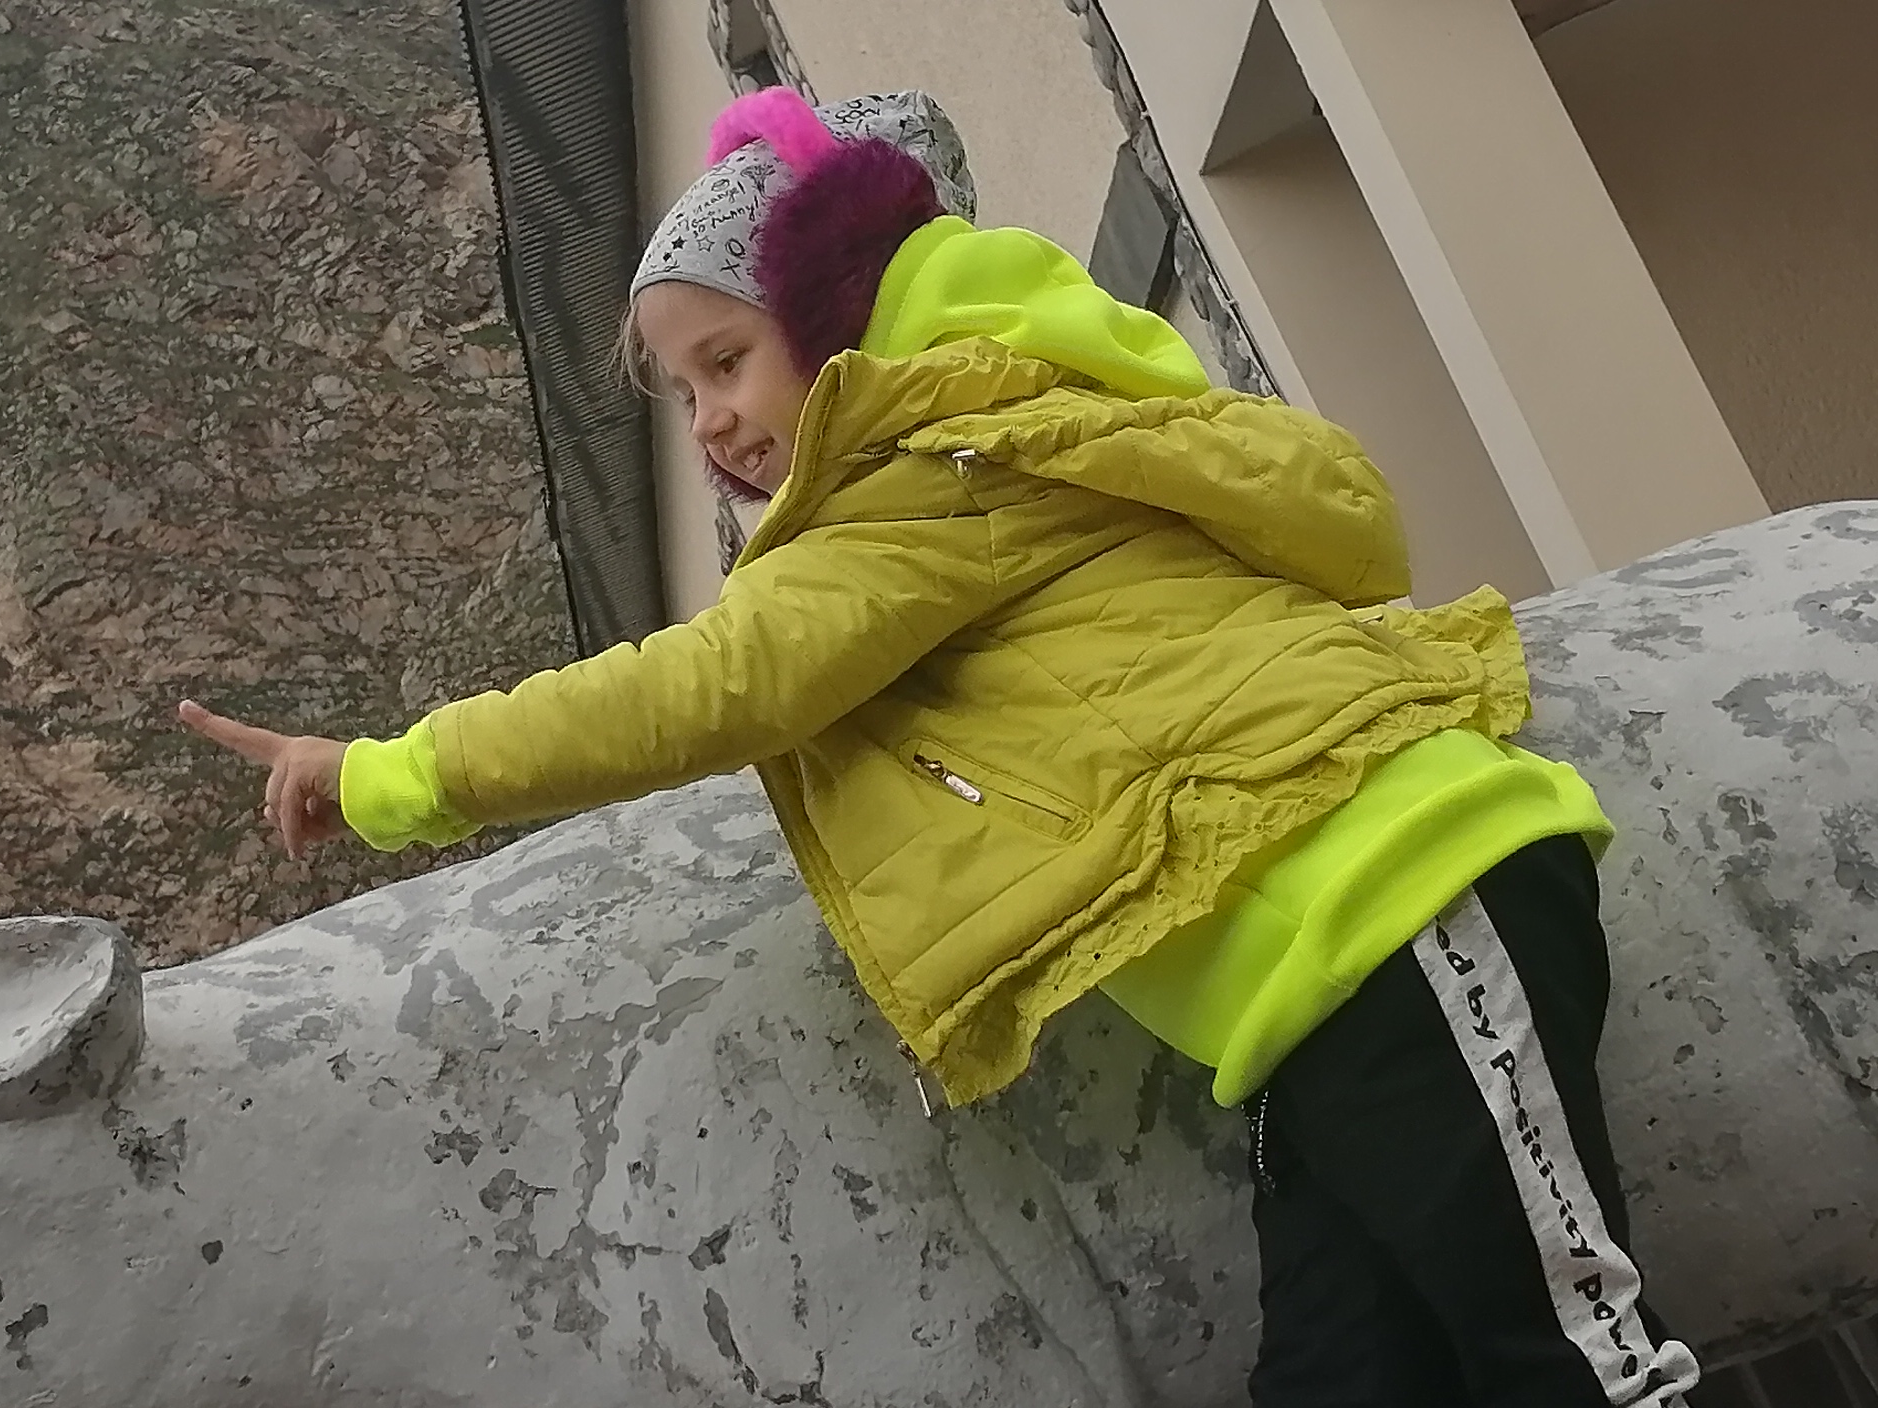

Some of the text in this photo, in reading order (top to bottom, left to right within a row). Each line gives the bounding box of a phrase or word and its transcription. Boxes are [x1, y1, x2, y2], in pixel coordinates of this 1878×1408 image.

[1435, 915, 1475, 976] ed
[1466, 983, 1501, 1040] by
[1572, 1271, 1653, 1385] powe
